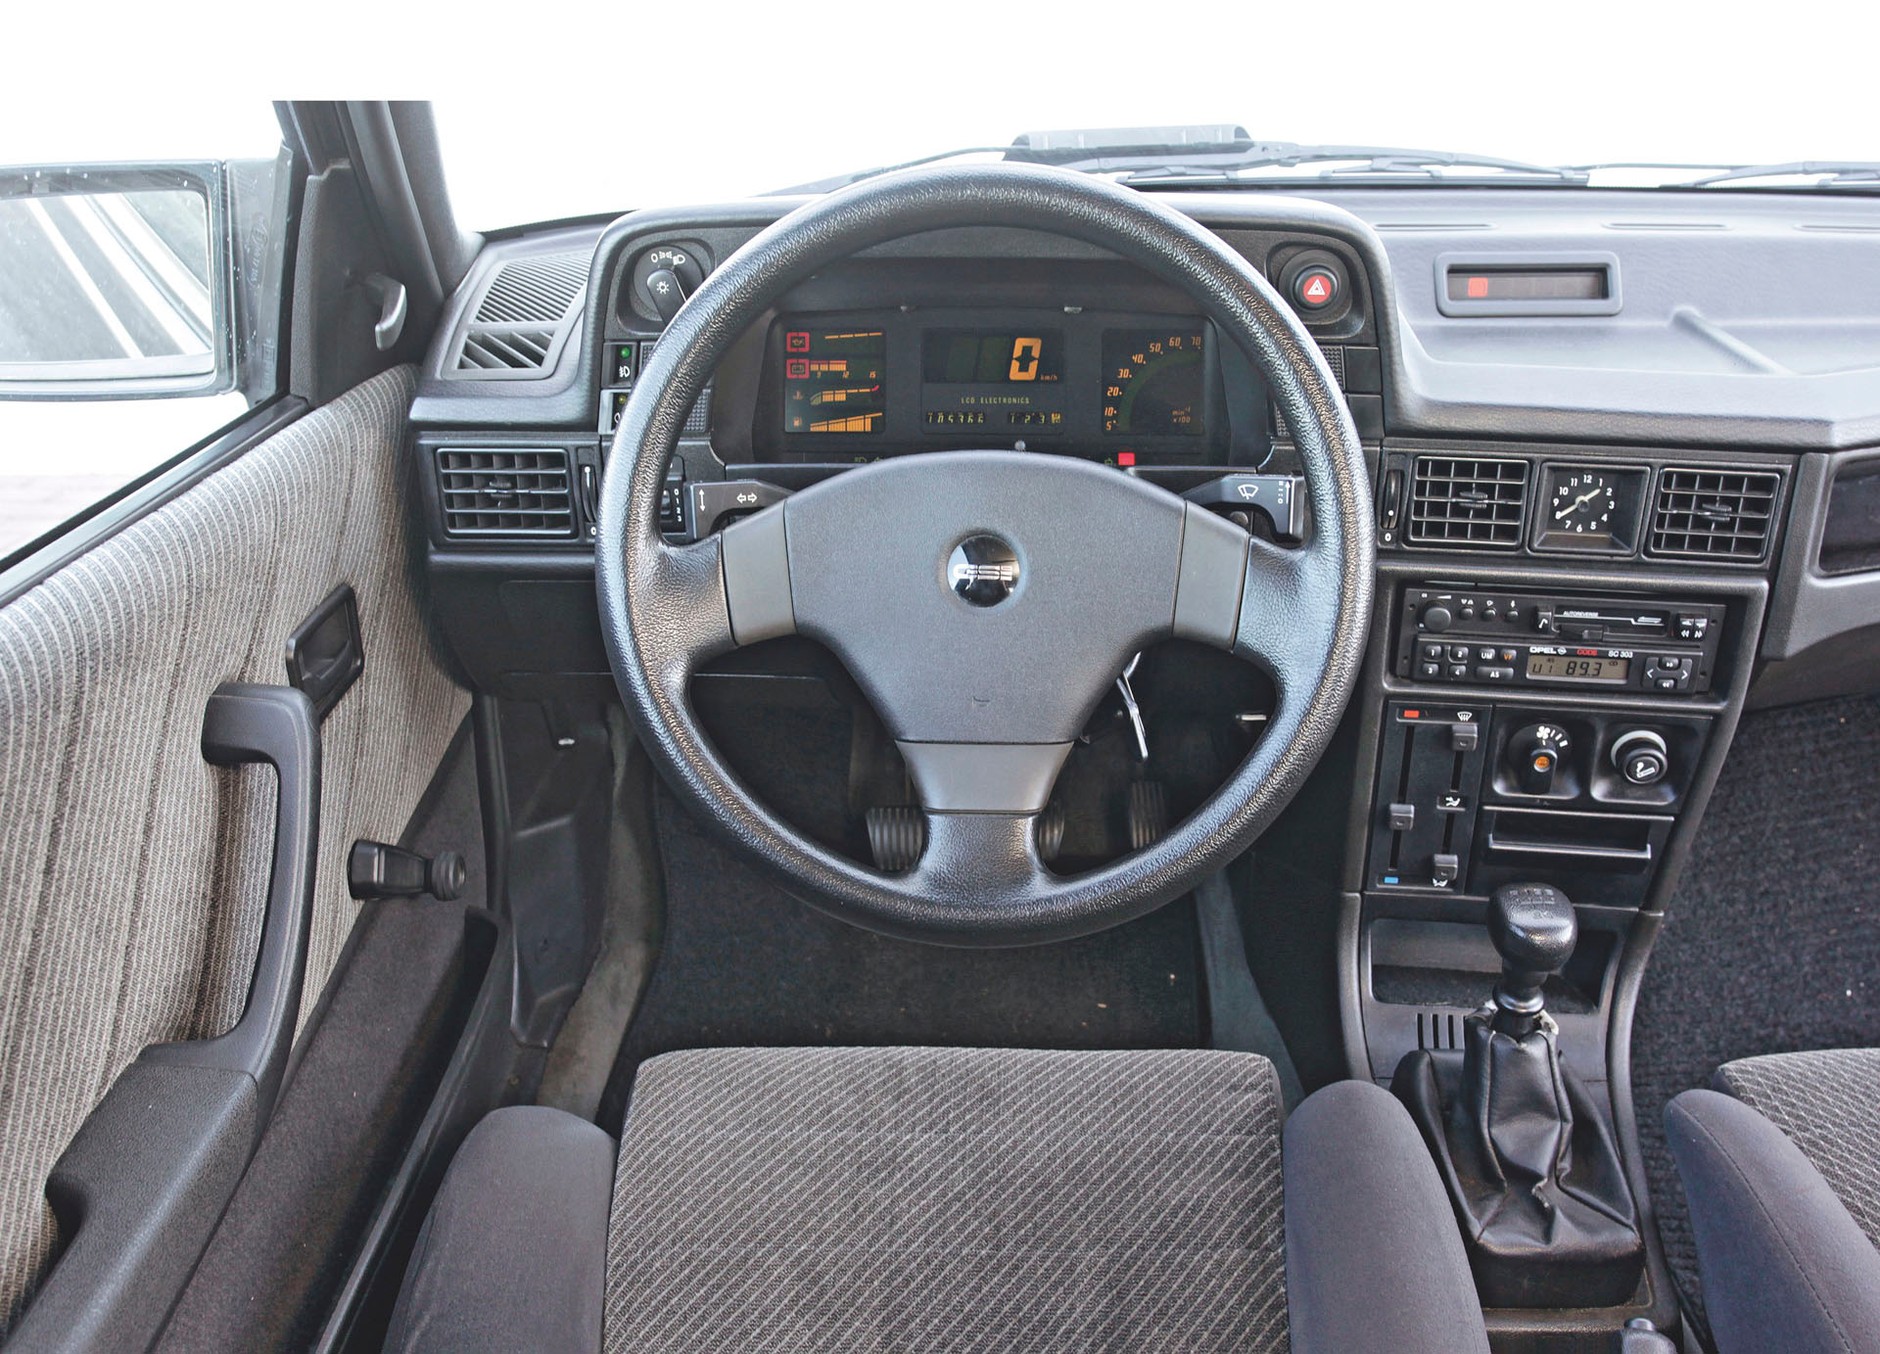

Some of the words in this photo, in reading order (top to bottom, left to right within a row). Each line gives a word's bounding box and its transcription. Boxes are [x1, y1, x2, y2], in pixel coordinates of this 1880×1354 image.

[1169, 336, 1181, 347] 60
[1149, 342, 1161, 353] 50
[1009, 337, 1042, 381] 0
[1132, 353, 1144, 364] 40
[1118, 368, 1130, 379] 30
[1107, 386, 1120, 397] 20
[980, 396, 1030, 405] ELECTRONICS
[1105, 407, 1114, 417] 10
[1106, 421, 1113, 431] 5
[1570, 477, 1578, 487] 11
[1583, 474, 1593, 484] 12
[1599, 478, 1603, 487] 1
[1559, 486, 1569, 496] 10
[1606, 487, 1613, 496] 2
[1553, 498, 1560, 507] 9
[1608, 500, 1615, 510] 3
[1555, 510, 1561, 520] 8
[1601, 513, 1608, 522] 4
[1565, 520, 1571, 529] 7
[1576, 523, 1583, 533] 6
[1590, 521, 1597, 530] 5
[1430, 649, 1435, 657] 1
[1457, 650, 1463, 658] 2
[1529, 646, 1557, 655] OPEL
[1576, 648, 1598, 657] CODE
[1608, 650, 1619, 658] SC
[1620, 650, 1633, 659] 303
[1455, 668, 1460, 676] 4
[1565, 660, 1603, 677] 89.3
[1490, 670, 1500, 678] AS
